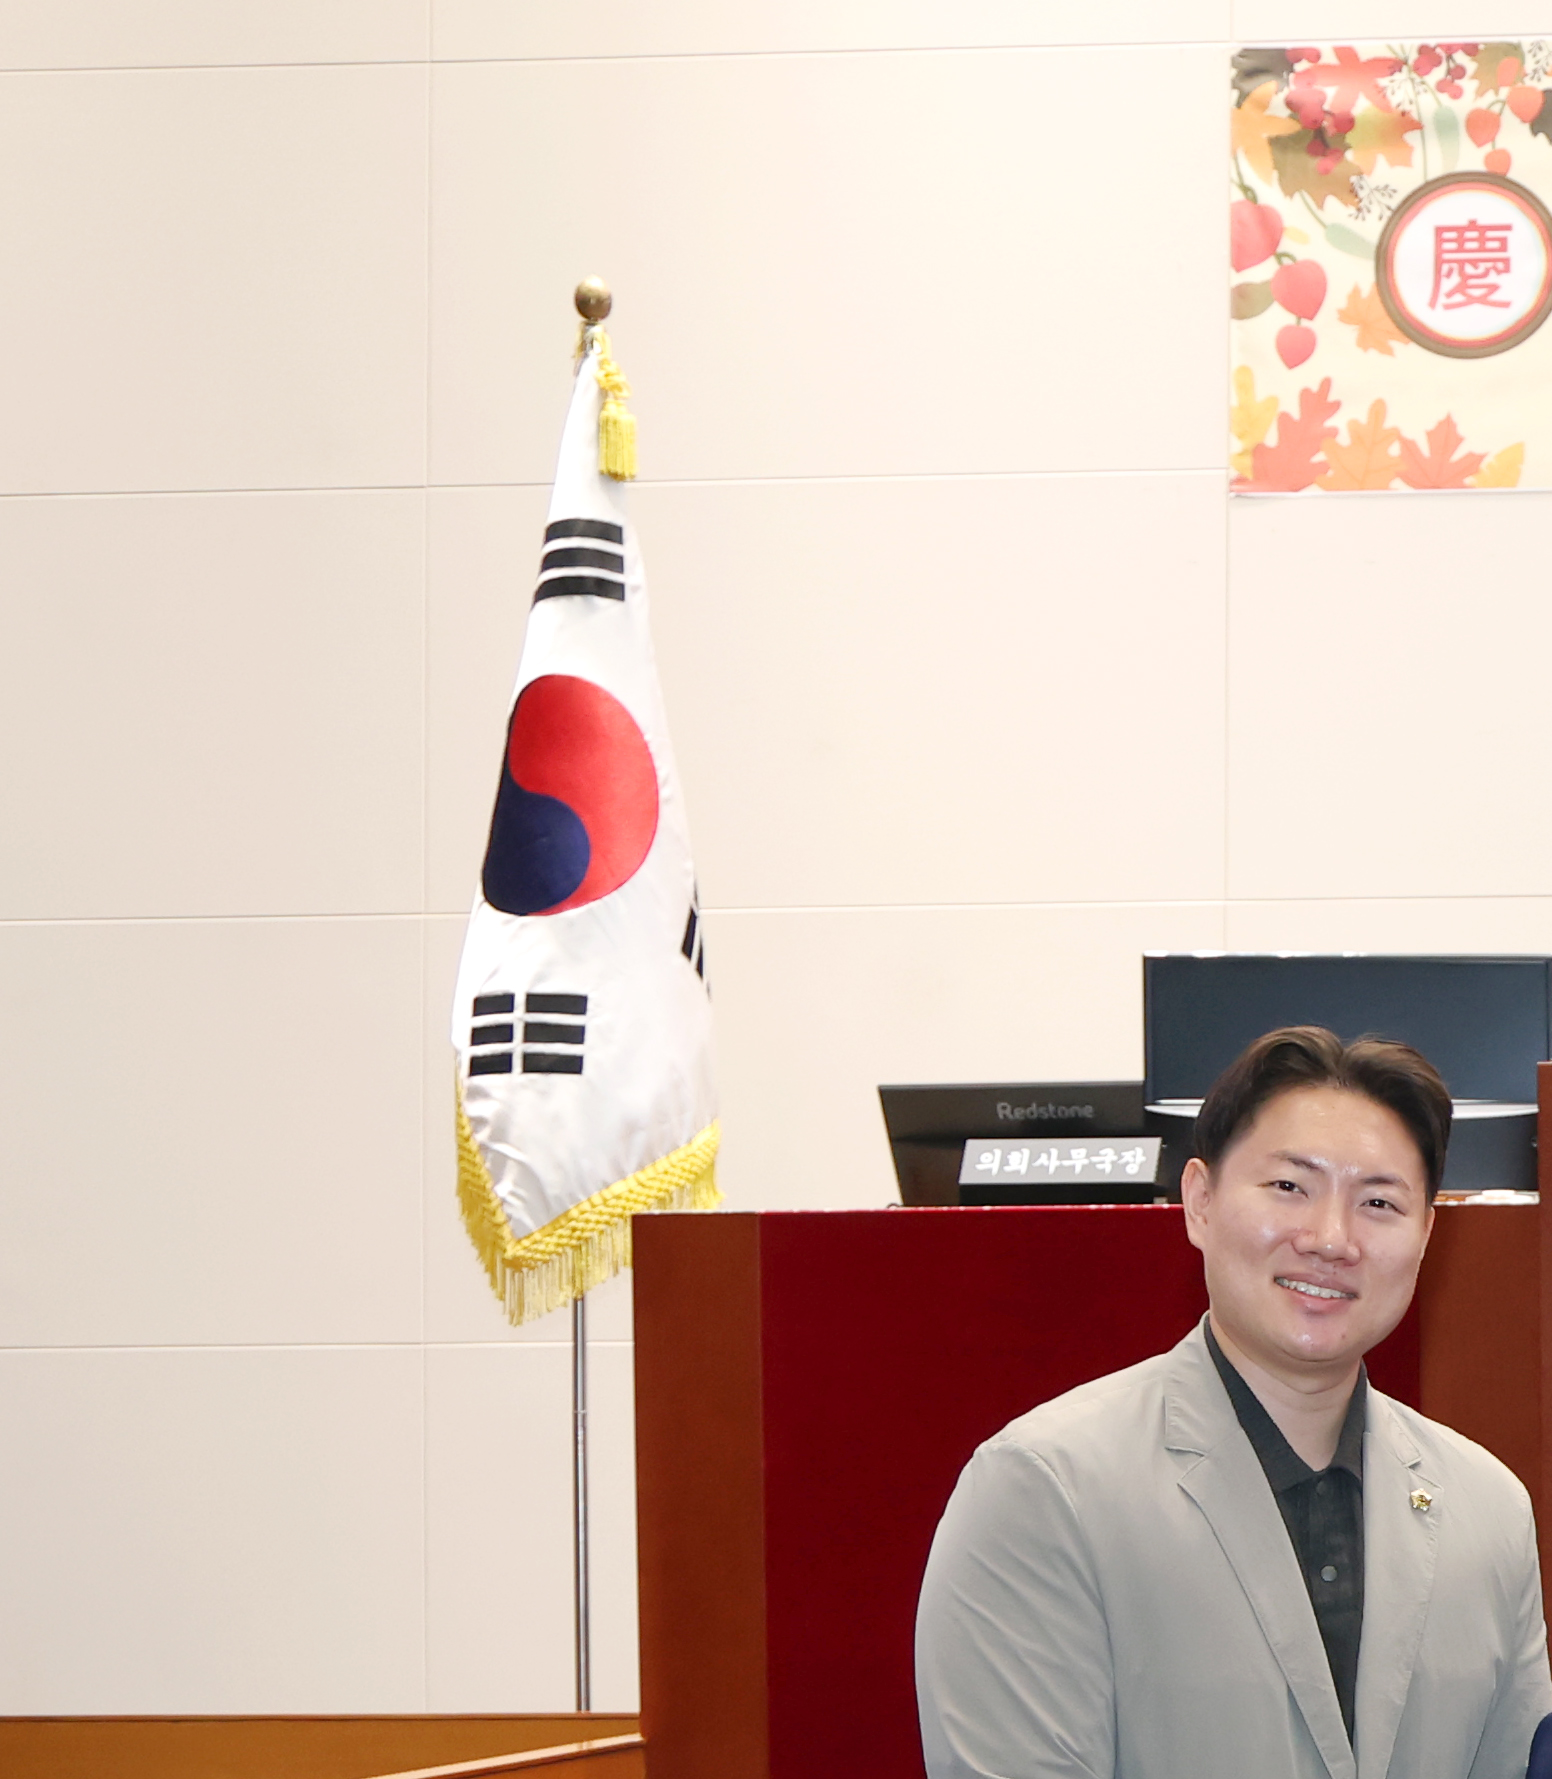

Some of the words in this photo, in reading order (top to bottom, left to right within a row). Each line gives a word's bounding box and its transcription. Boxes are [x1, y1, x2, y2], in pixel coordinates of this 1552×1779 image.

[1427, 219, 1513, 311] 慶
[995, 1101, 1096, 1121] Redstone
[974, 1146, 1148, 1177] 의회사무국장
